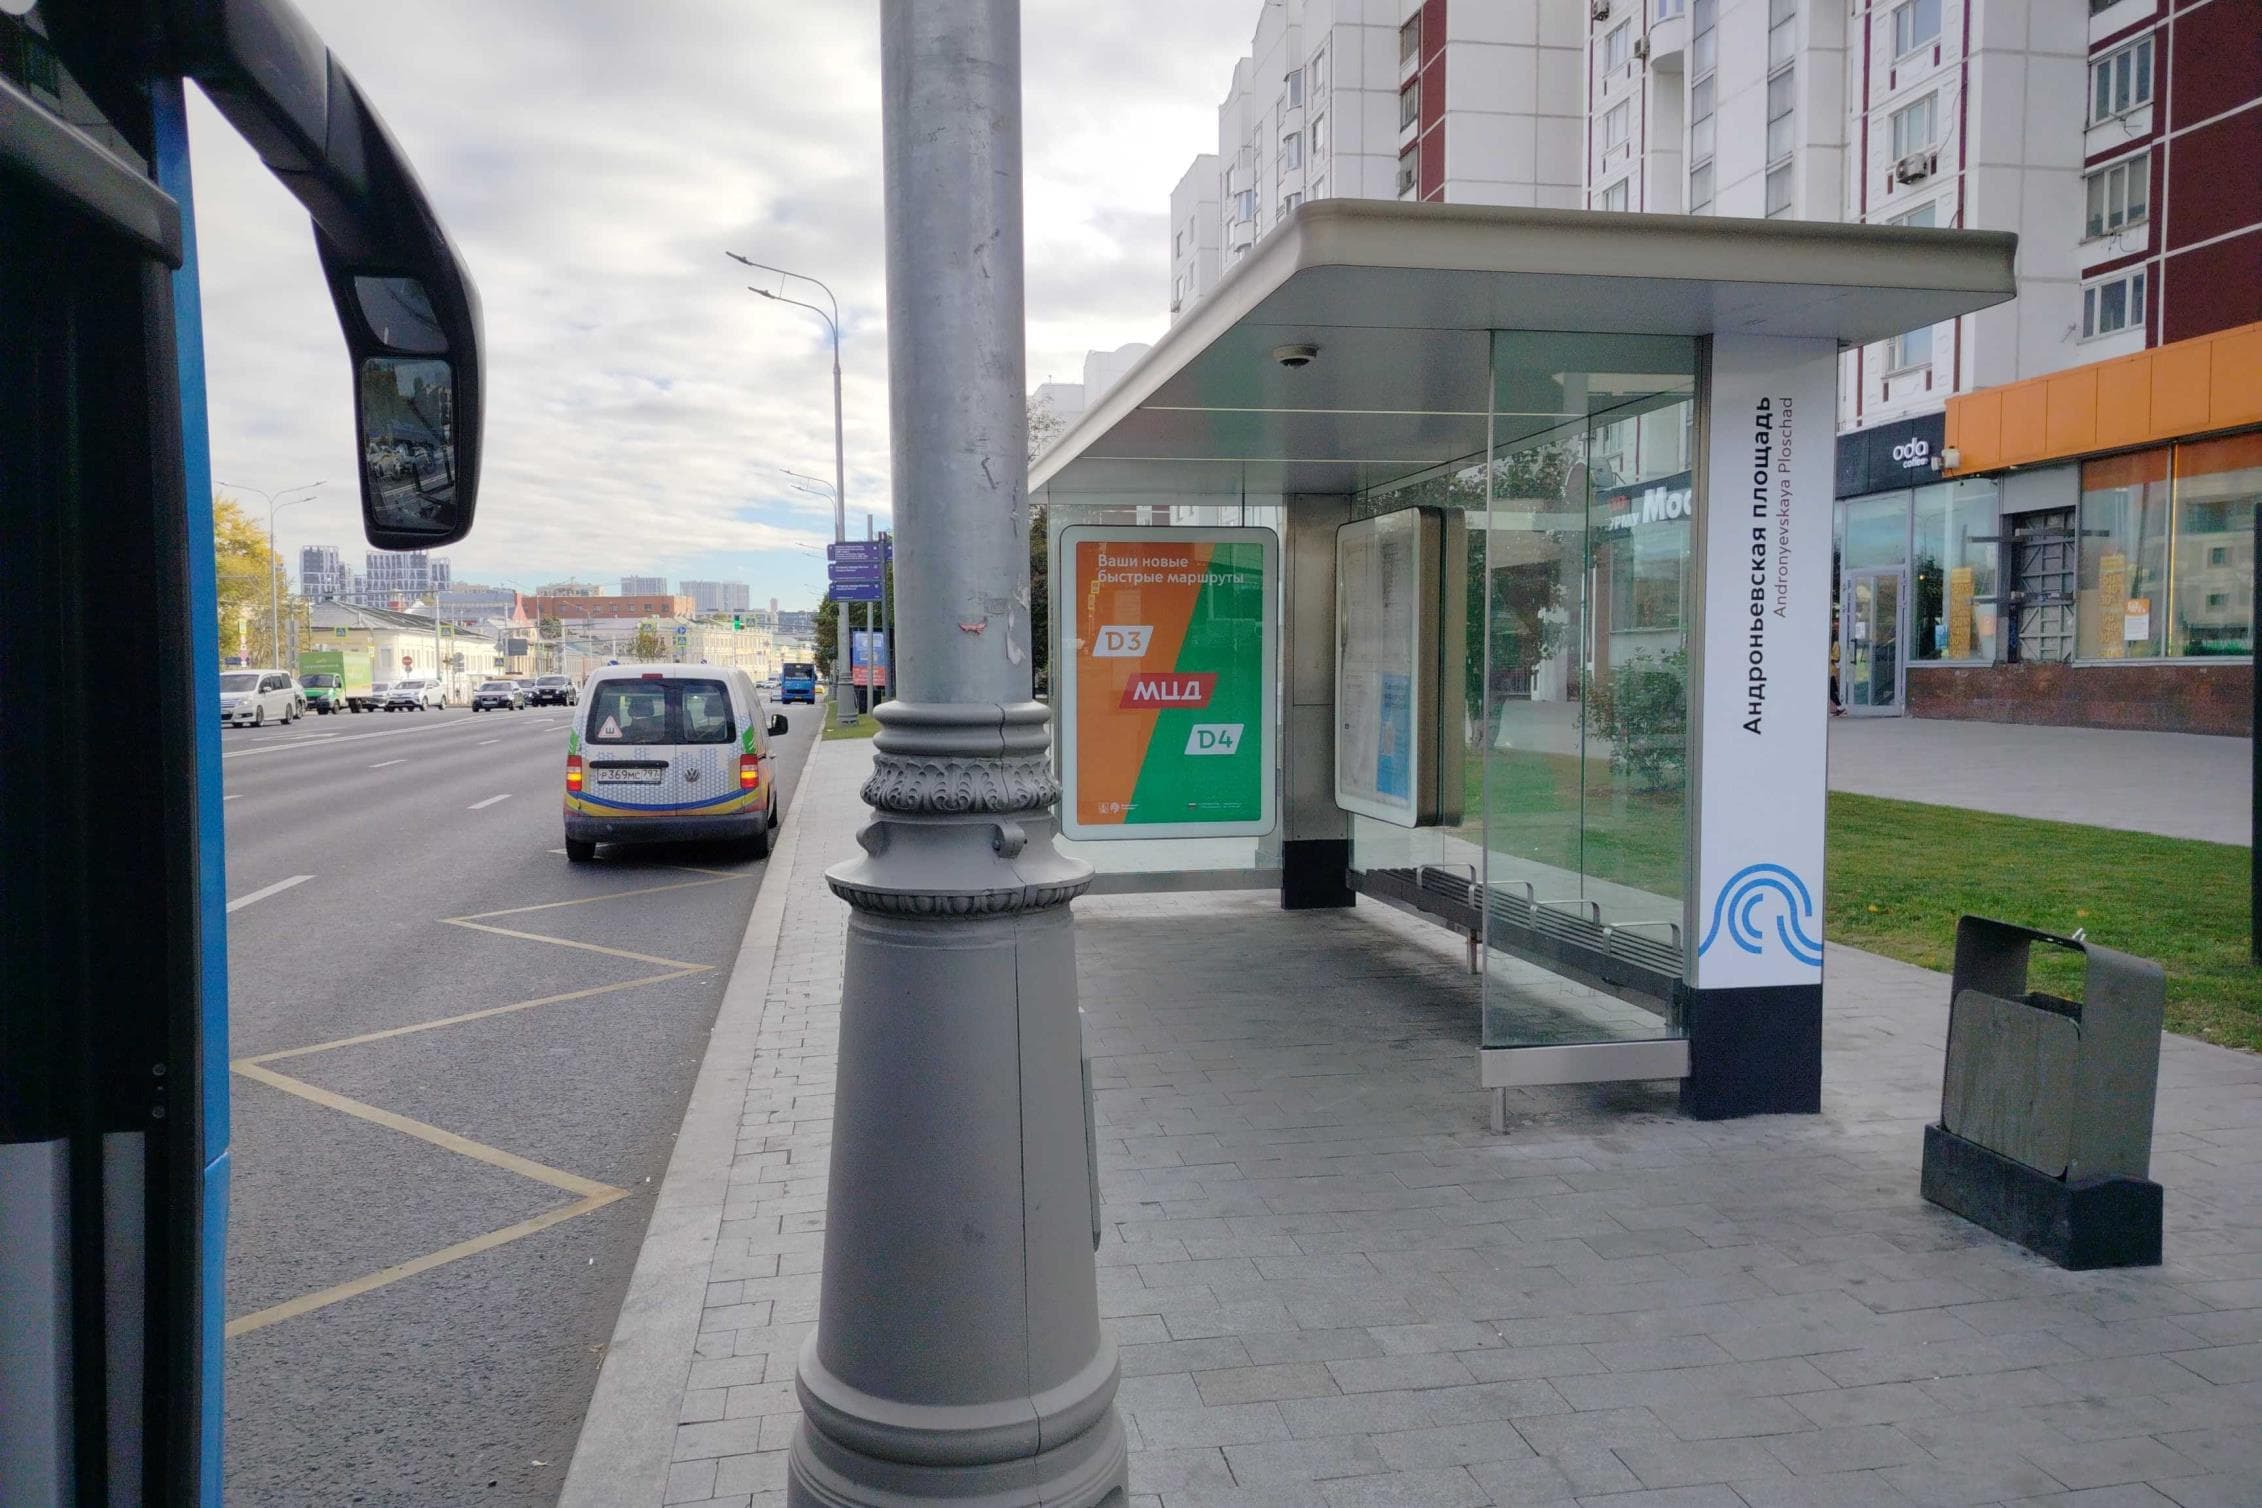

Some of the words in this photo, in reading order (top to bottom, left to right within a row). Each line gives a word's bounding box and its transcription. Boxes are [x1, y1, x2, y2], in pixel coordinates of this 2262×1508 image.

[1777, 396, 1793, 473] Ploschad
[1750, 396, 1772, 518] площадь
[1893, 437, 1929, 461] oda
[1773, 479, 1793, 618] Andronyevskaya
[1098, 555, 1138, 568] Ваши
[1142, 556, 1189, 568] новые
[1098, 569, 1163, 585] быстрые
[1167, 571, 1244, 586] маршруты
[1105, 630, 1142, 652] D3
[1742, 527, 1768, 736] Андроньевская
[1132, 681, 1202, 702] МЦД
[1196, 729, 1233, 748] D4
